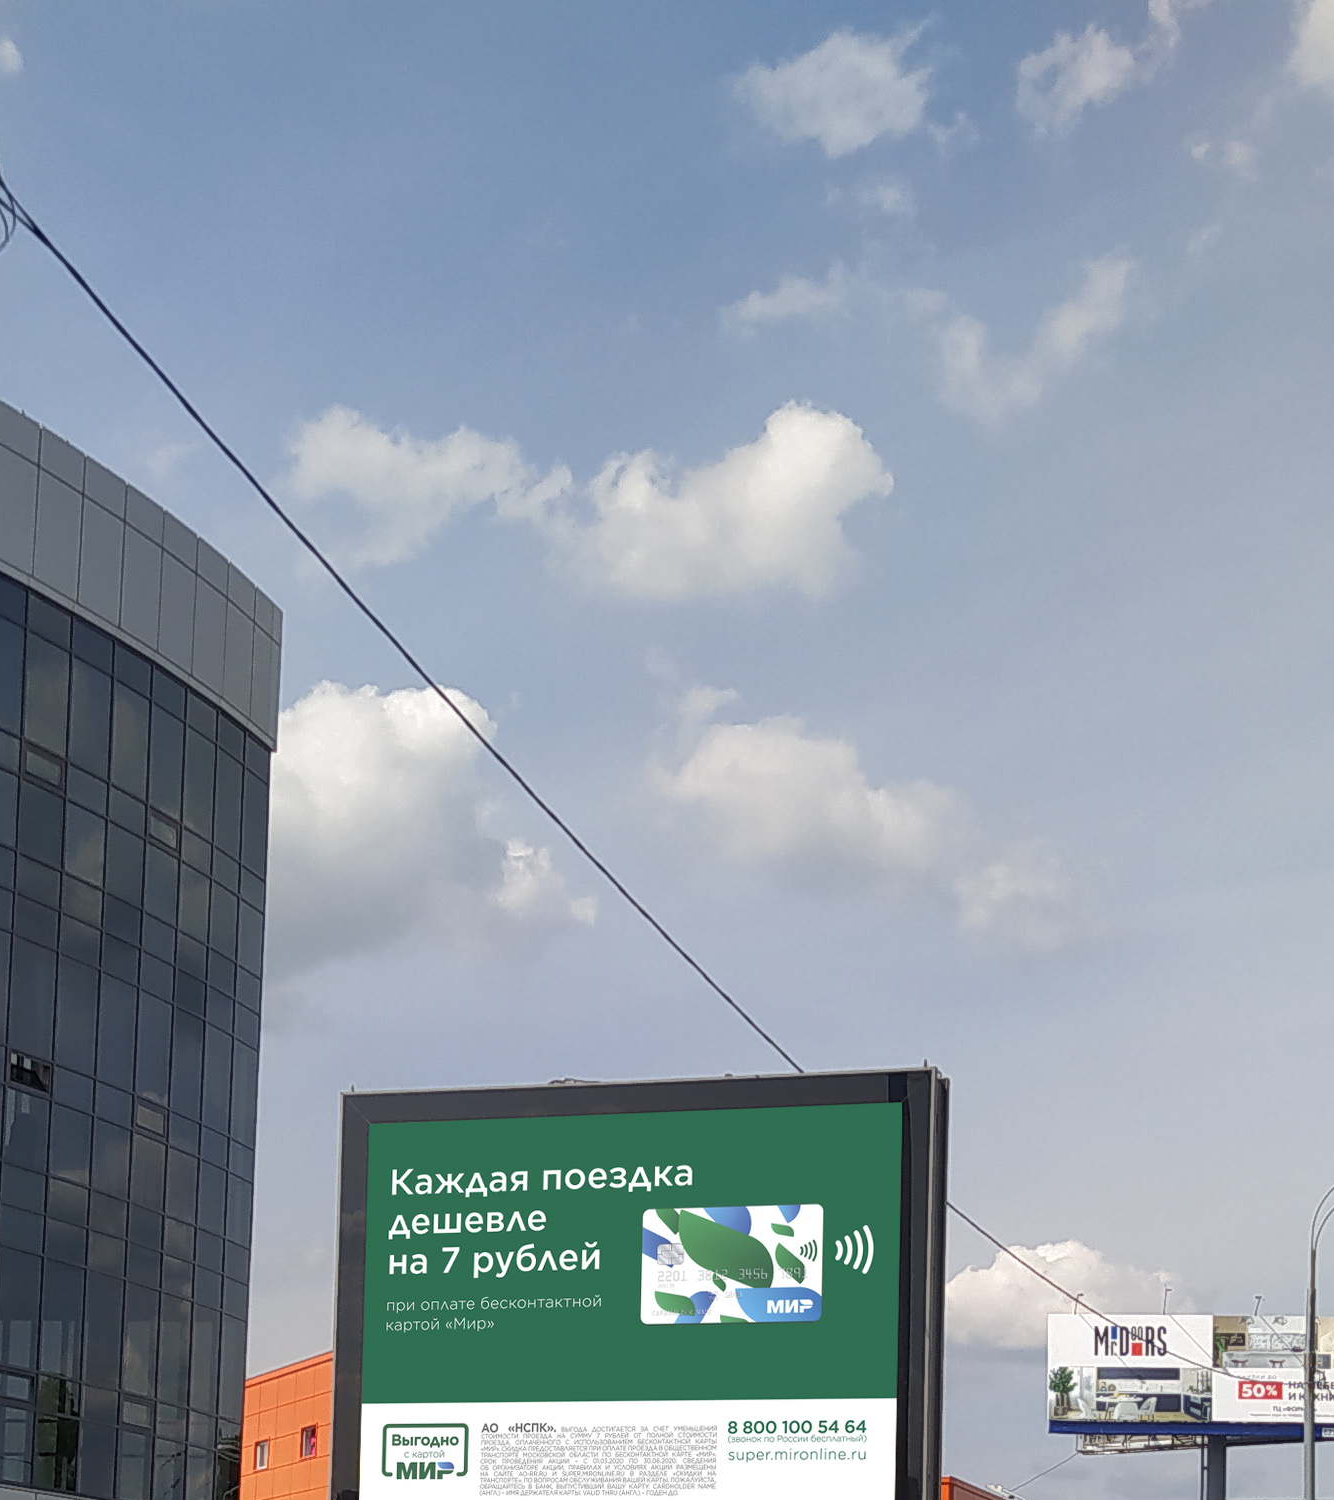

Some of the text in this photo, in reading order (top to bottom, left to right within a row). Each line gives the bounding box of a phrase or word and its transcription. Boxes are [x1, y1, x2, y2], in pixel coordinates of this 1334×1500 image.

[390, 1164, 694, 1198] Каждая поездка
[387, 1208, 547, 1240] дешевле
[388, 1241, 601, 1279] на 7 рублей
[386, 1294, 602, 1314] при оплате бесконтактной
[767, 1299, 814, 1314] МИР
[386, 1316, 495, 1333] картой «Мир»
[1241, 1384, 1278, 1398] 50%
[481, 1423, 498, 1433] АО
[508, 1422, 557, 1433] «НСПК».
[727, 1420, 867, 1434] 8 800 100 54 64
[392, 1434, 459, 1448] Выгодно
[727, 1435, 762, 1444] (звонок
[777, 1435, 808, 1443] России
[810, 1434, 867, 1444] бесплатный)
[412, 1450, 445, 1459] картой
[728, 1448, 867, 1463] super.mironline.ru
[396, 1461, 455, 1480] МИР
